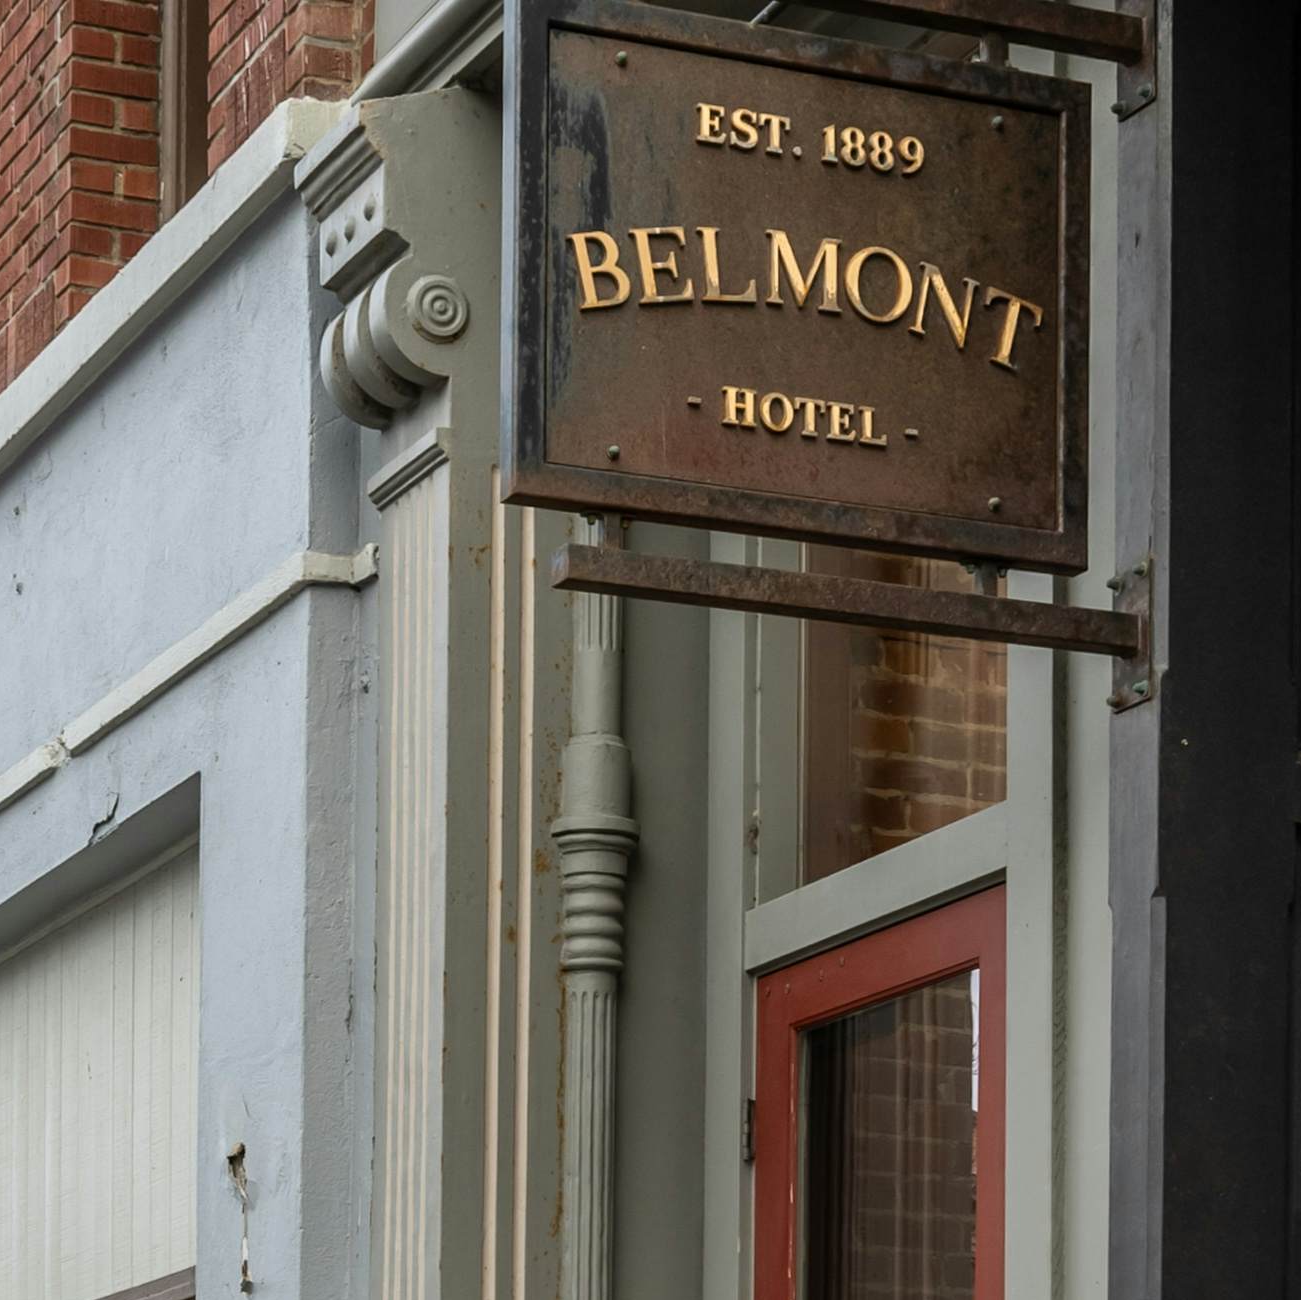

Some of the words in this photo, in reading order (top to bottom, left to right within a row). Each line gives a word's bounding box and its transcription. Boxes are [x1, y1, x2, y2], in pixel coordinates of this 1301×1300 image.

[695, 102, 804, 156] EST.
[820, 123, 926, 177] 1889
[566, 225, 1044, 371] BELMONT
[720, 386, 888, 448] HOTEL
